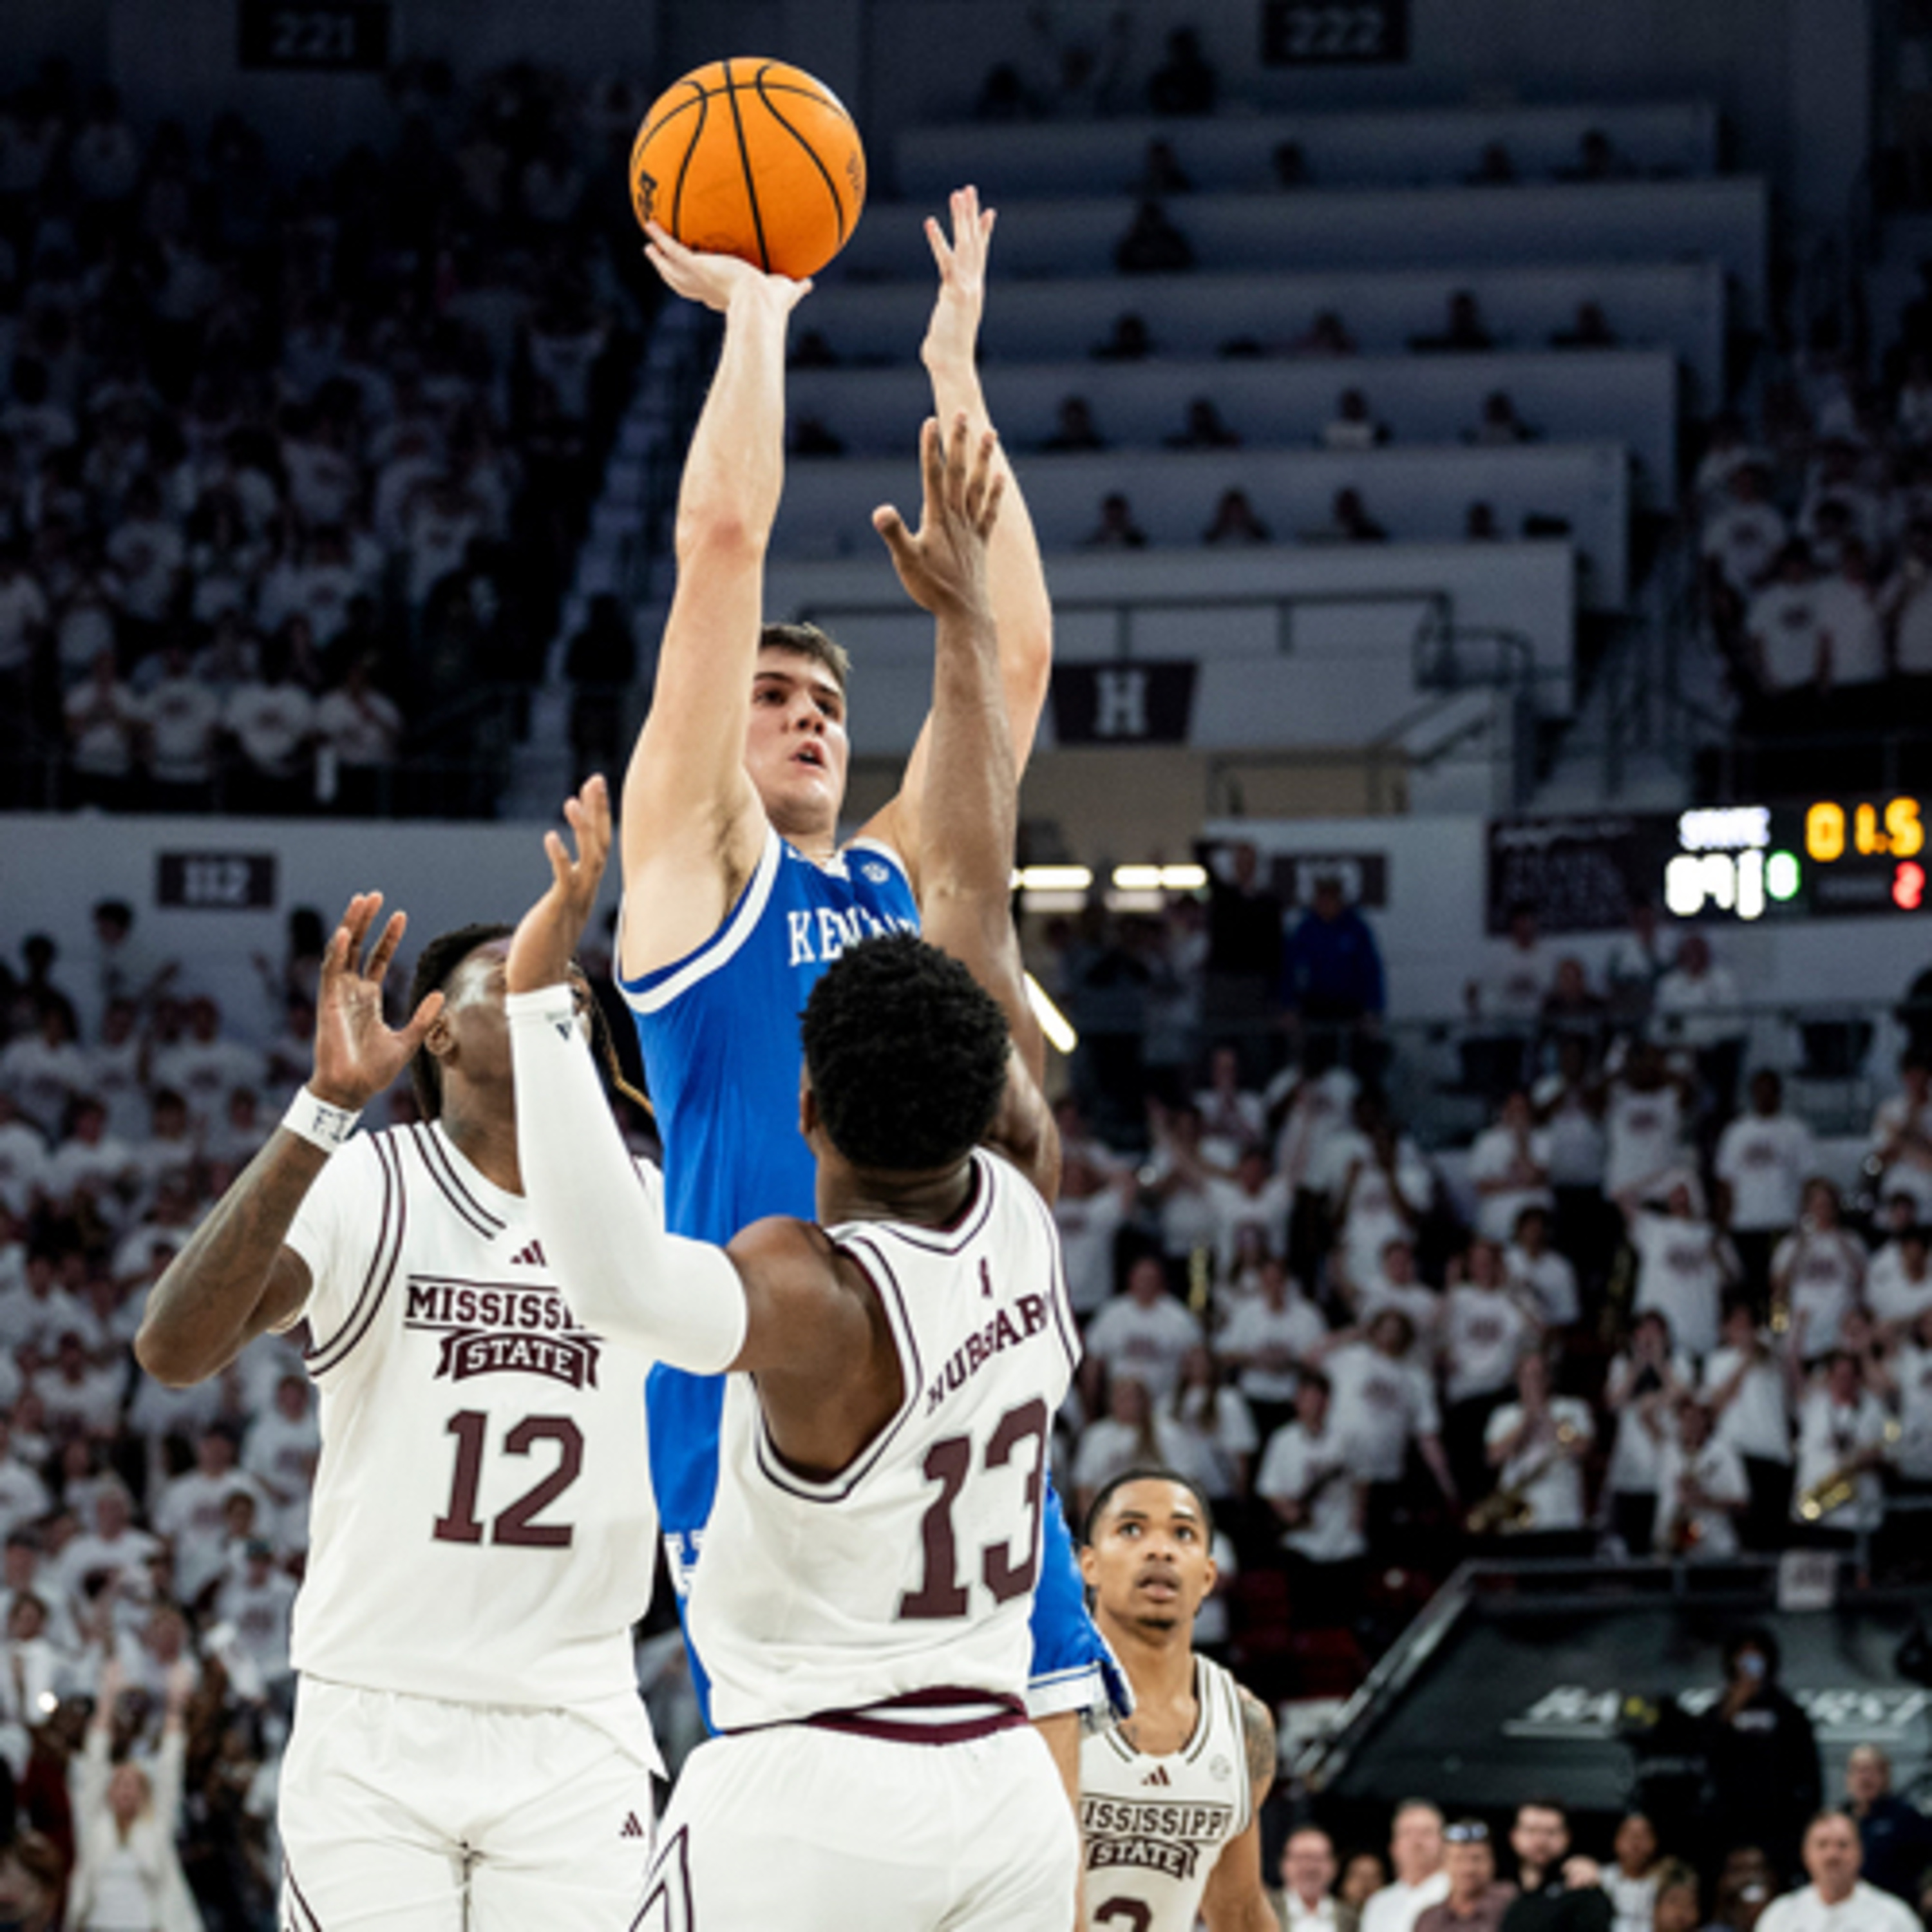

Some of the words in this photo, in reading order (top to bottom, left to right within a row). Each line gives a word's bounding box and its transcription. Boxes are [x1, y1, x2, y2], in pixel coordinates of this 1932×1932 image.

[270, 8, 355, 59] 221
[1284, 5, 1386, 56] 222
[1095, 668, 1151, 738] H
[466, 1338, 574, 1377] STATE
[433, 1409, 584, 1548] 12
[900, 1397, 1048, 1619] 13
[1097, 1839, 1184, 1875] STATE
